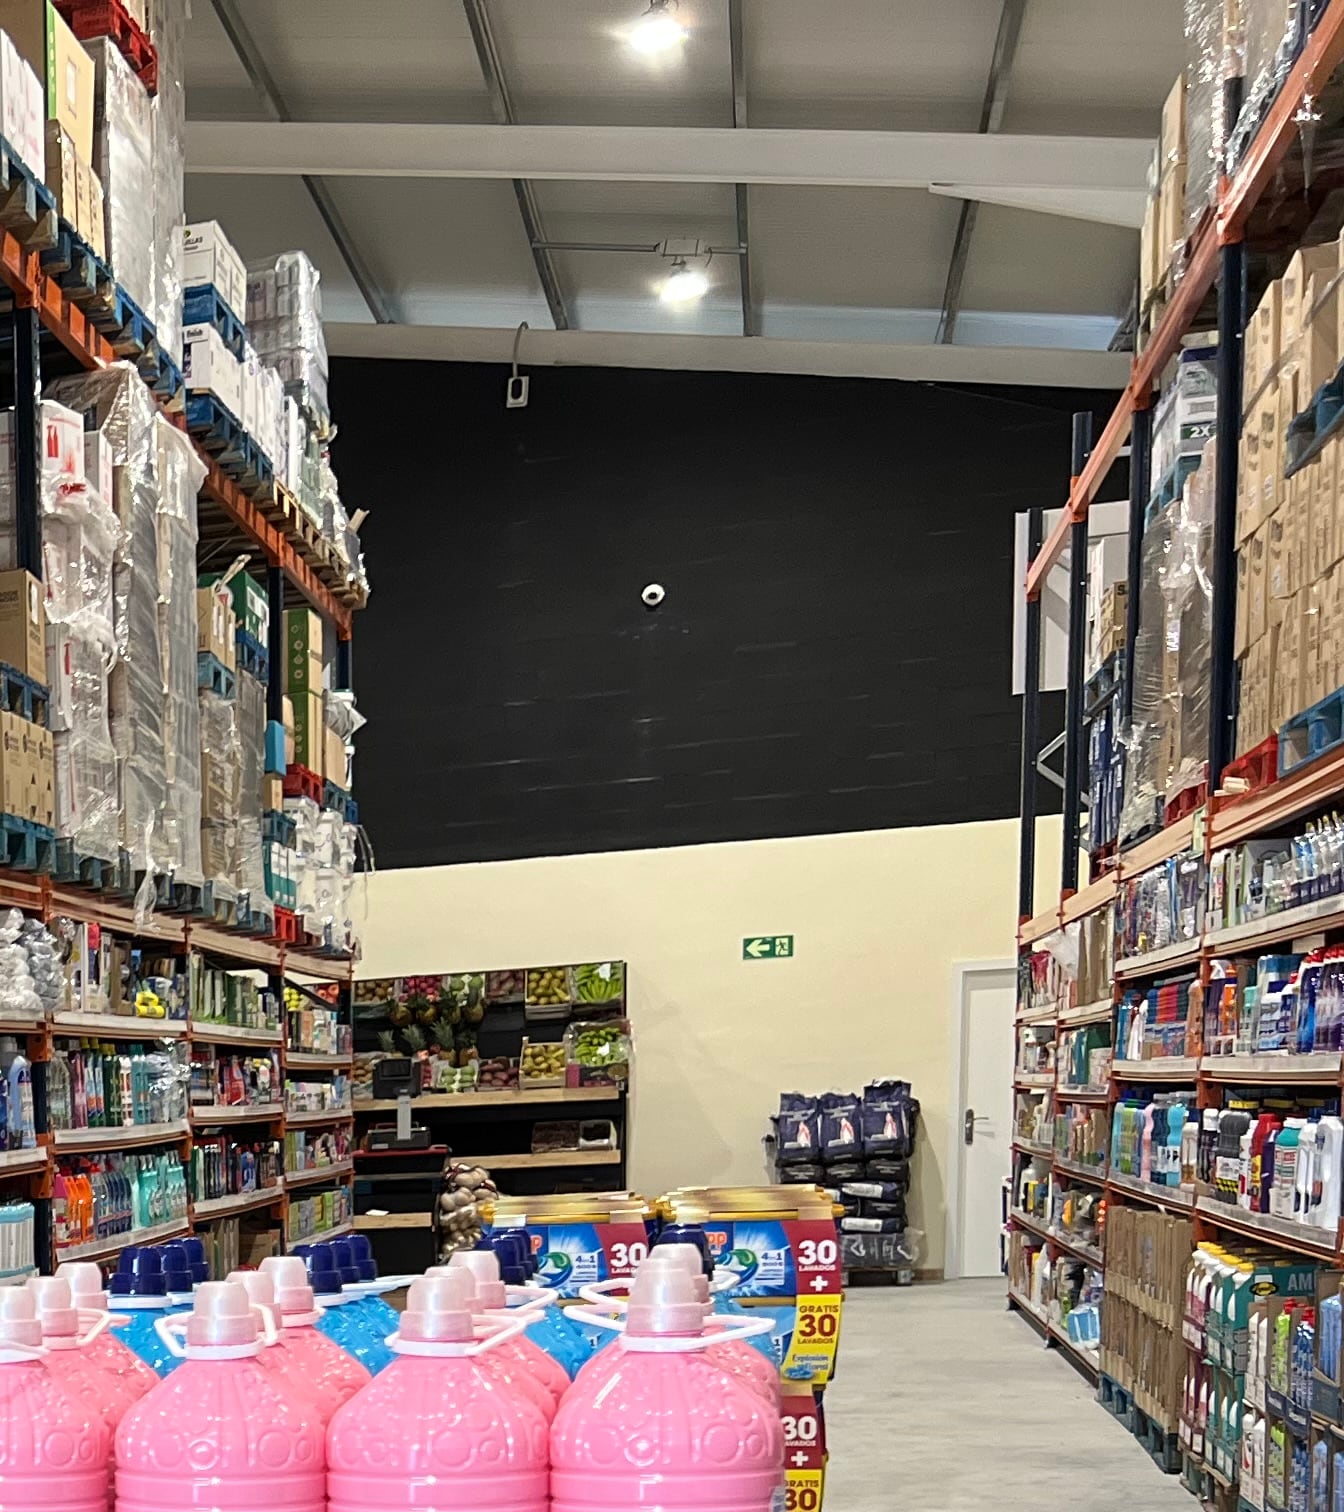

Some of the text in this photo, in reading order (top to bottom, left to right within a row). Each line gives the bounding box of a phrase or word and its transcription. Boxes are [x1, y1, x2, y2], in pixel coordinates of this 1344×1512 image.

[798, 1240, 838, 1264] 30
[799, 1304, 839, 1314] GRATIS
[798, 1314, 837, 1338] 30
